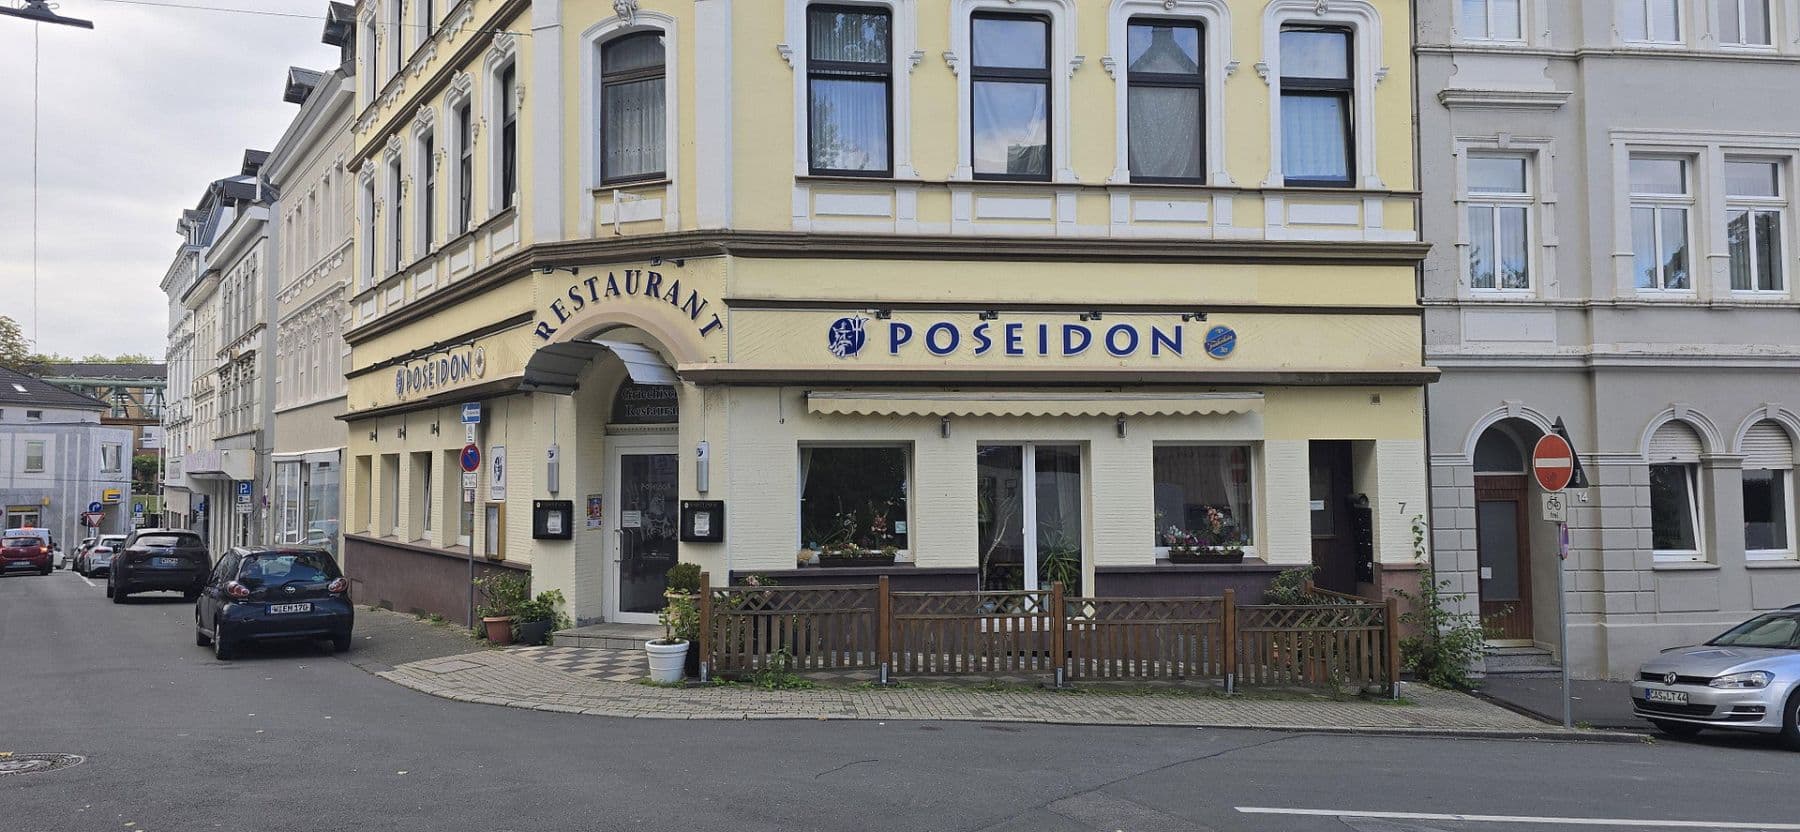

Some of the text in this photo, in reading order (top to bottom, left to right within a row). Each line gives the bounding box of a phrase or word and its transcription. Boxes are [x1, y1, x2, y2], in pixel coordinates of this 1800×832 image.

[534, 269, 723, 342] RESTAURANT
[888, 321, 1184, 356] POSEIDON
[406, 351, 472, 393] POSEIDON
[1398, 502, 1406, 514] 7
[1577, 491, 1588, 503] 14
